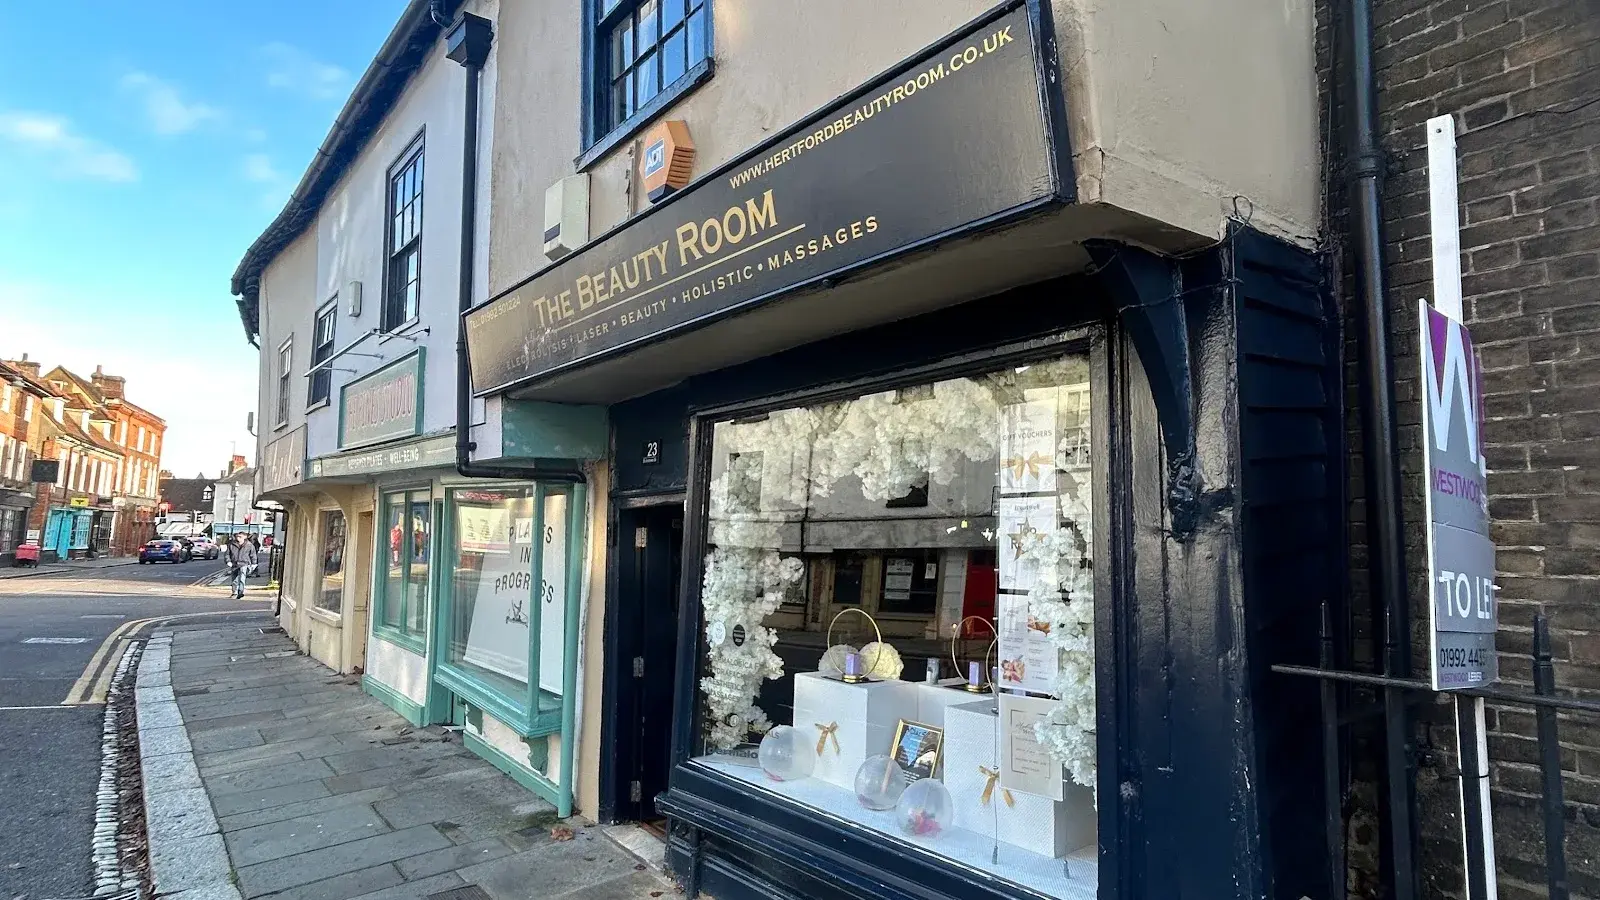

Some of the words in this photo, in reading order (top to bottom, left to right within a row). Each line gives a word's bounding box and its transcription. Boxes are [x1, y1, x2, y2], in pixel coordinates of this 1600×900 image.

[729, 25, 1015, 189] WWW.HERTFORDBEAUTYROOM.CO.UK
[646, 144, 664, 172] ADT
[533, 289, 575, 328] THE
[576, 239, 670, 311] BEAUTY
[676, 189, 778, 267] ROOM
[576, 322, 609, 344] LASER
[620, 299, 667, 327] BEAUTY
[682, 265, 753, 304] HOLISTIC
[767, 216, 879, 272] MASSAGES
[1018, 430, 1052, 439] VOUCHERS
[647, 442, 658, 457] 23
[509, 522, 553, 544] PILAS
[520, 547, 532, 563] IN
[495, 572, 554, 603] PROGRSS
[1439, 571, 1471, 618] TO
[1440, 648, 1466, 667] 01992
